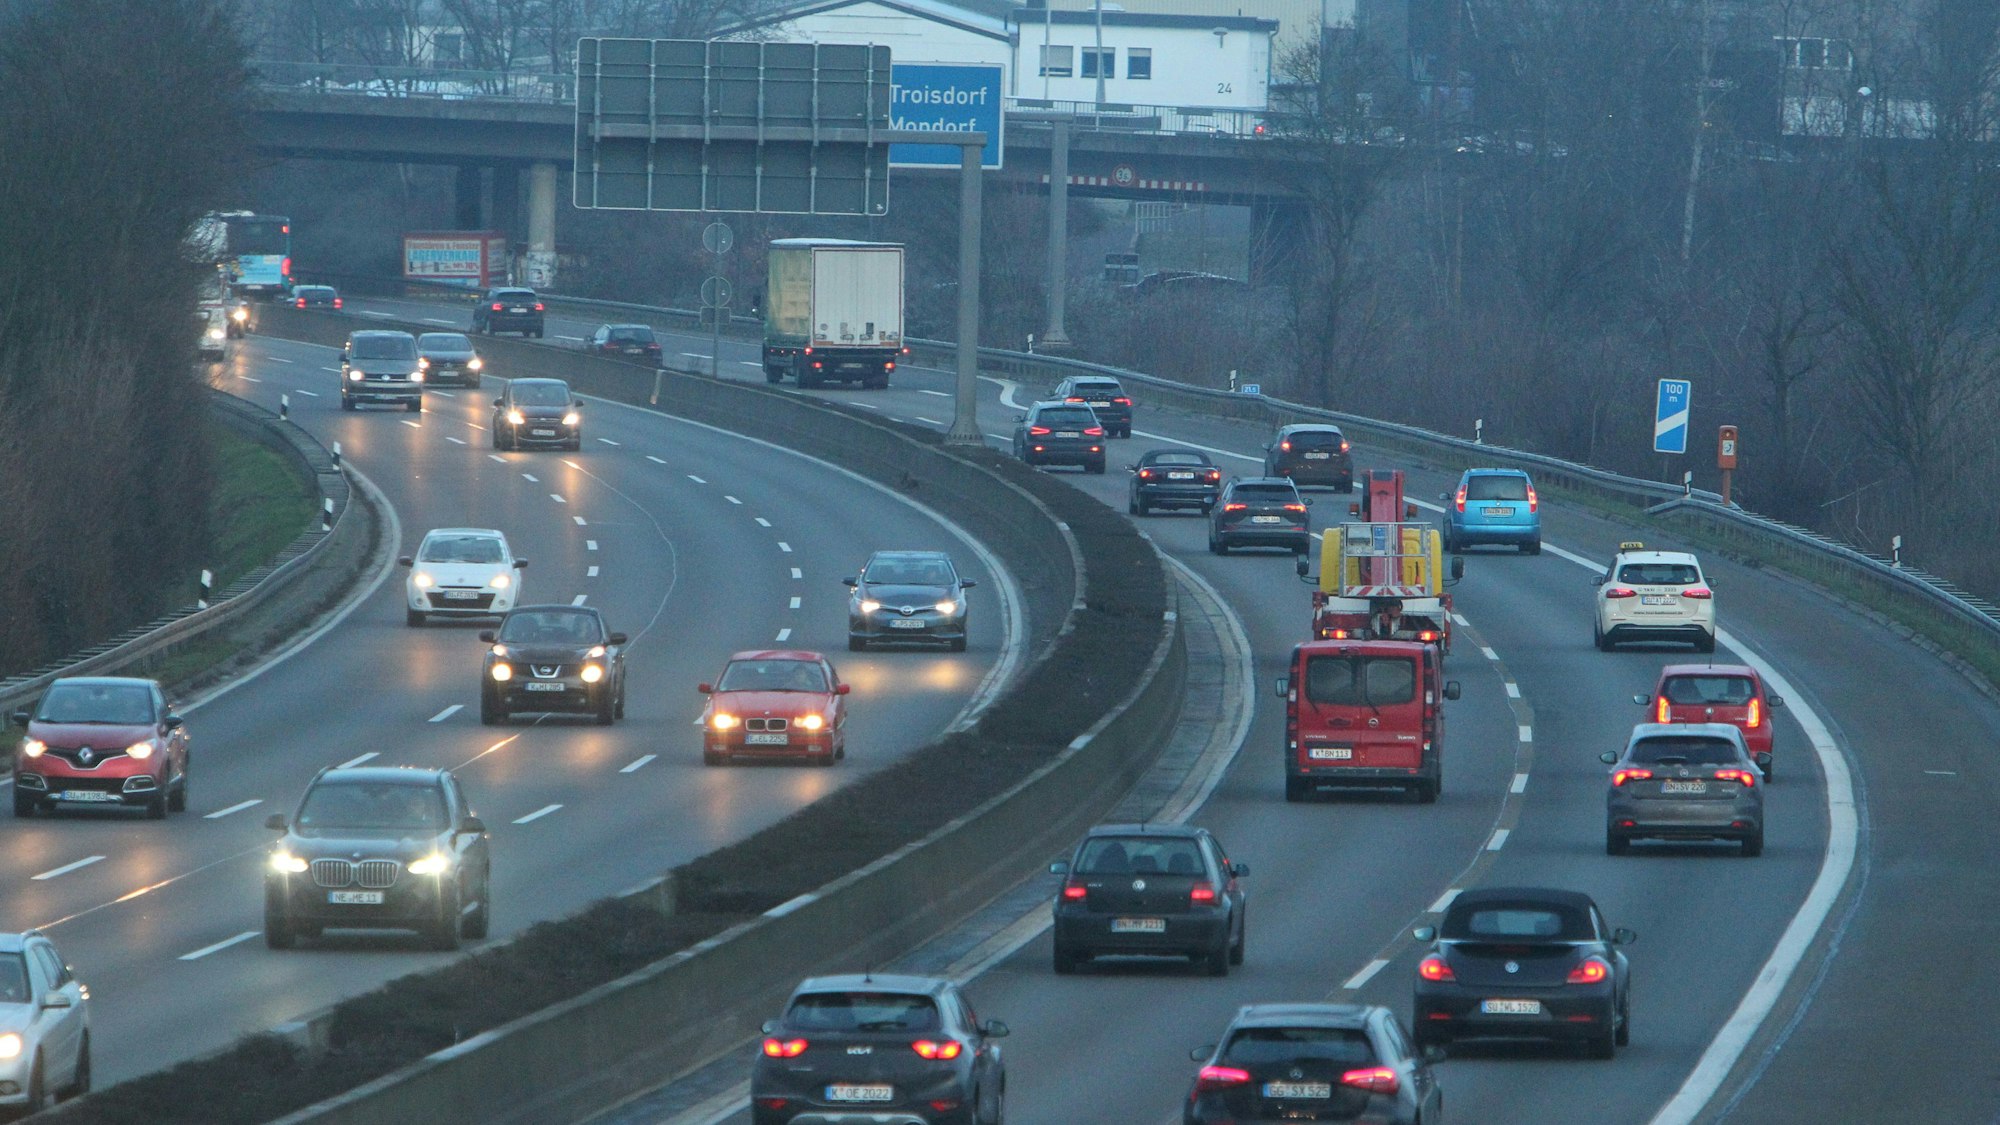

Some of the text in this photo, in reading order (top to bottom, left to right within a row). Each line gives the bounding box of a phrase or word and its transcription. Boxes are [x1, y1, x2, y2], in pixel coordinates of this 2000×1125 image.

[1217, 82, 1232, 94] 24
[891, 85, 988, 105] Troisdorf
[889, 116, 976, 131] Mondorf
[408, 250, 480, 261] LAGERVERKAUF
[1666, 384, 1683, 394] 100
[1487, 1002, 1498, 1012] SU
[1504, 1002, 1515, 1012] WL
[846, 1088, 860, 1099] OE
[862, 1088, 889, 1099] 2022
[1270, 1085, 1329, 1097] GG SX 525
